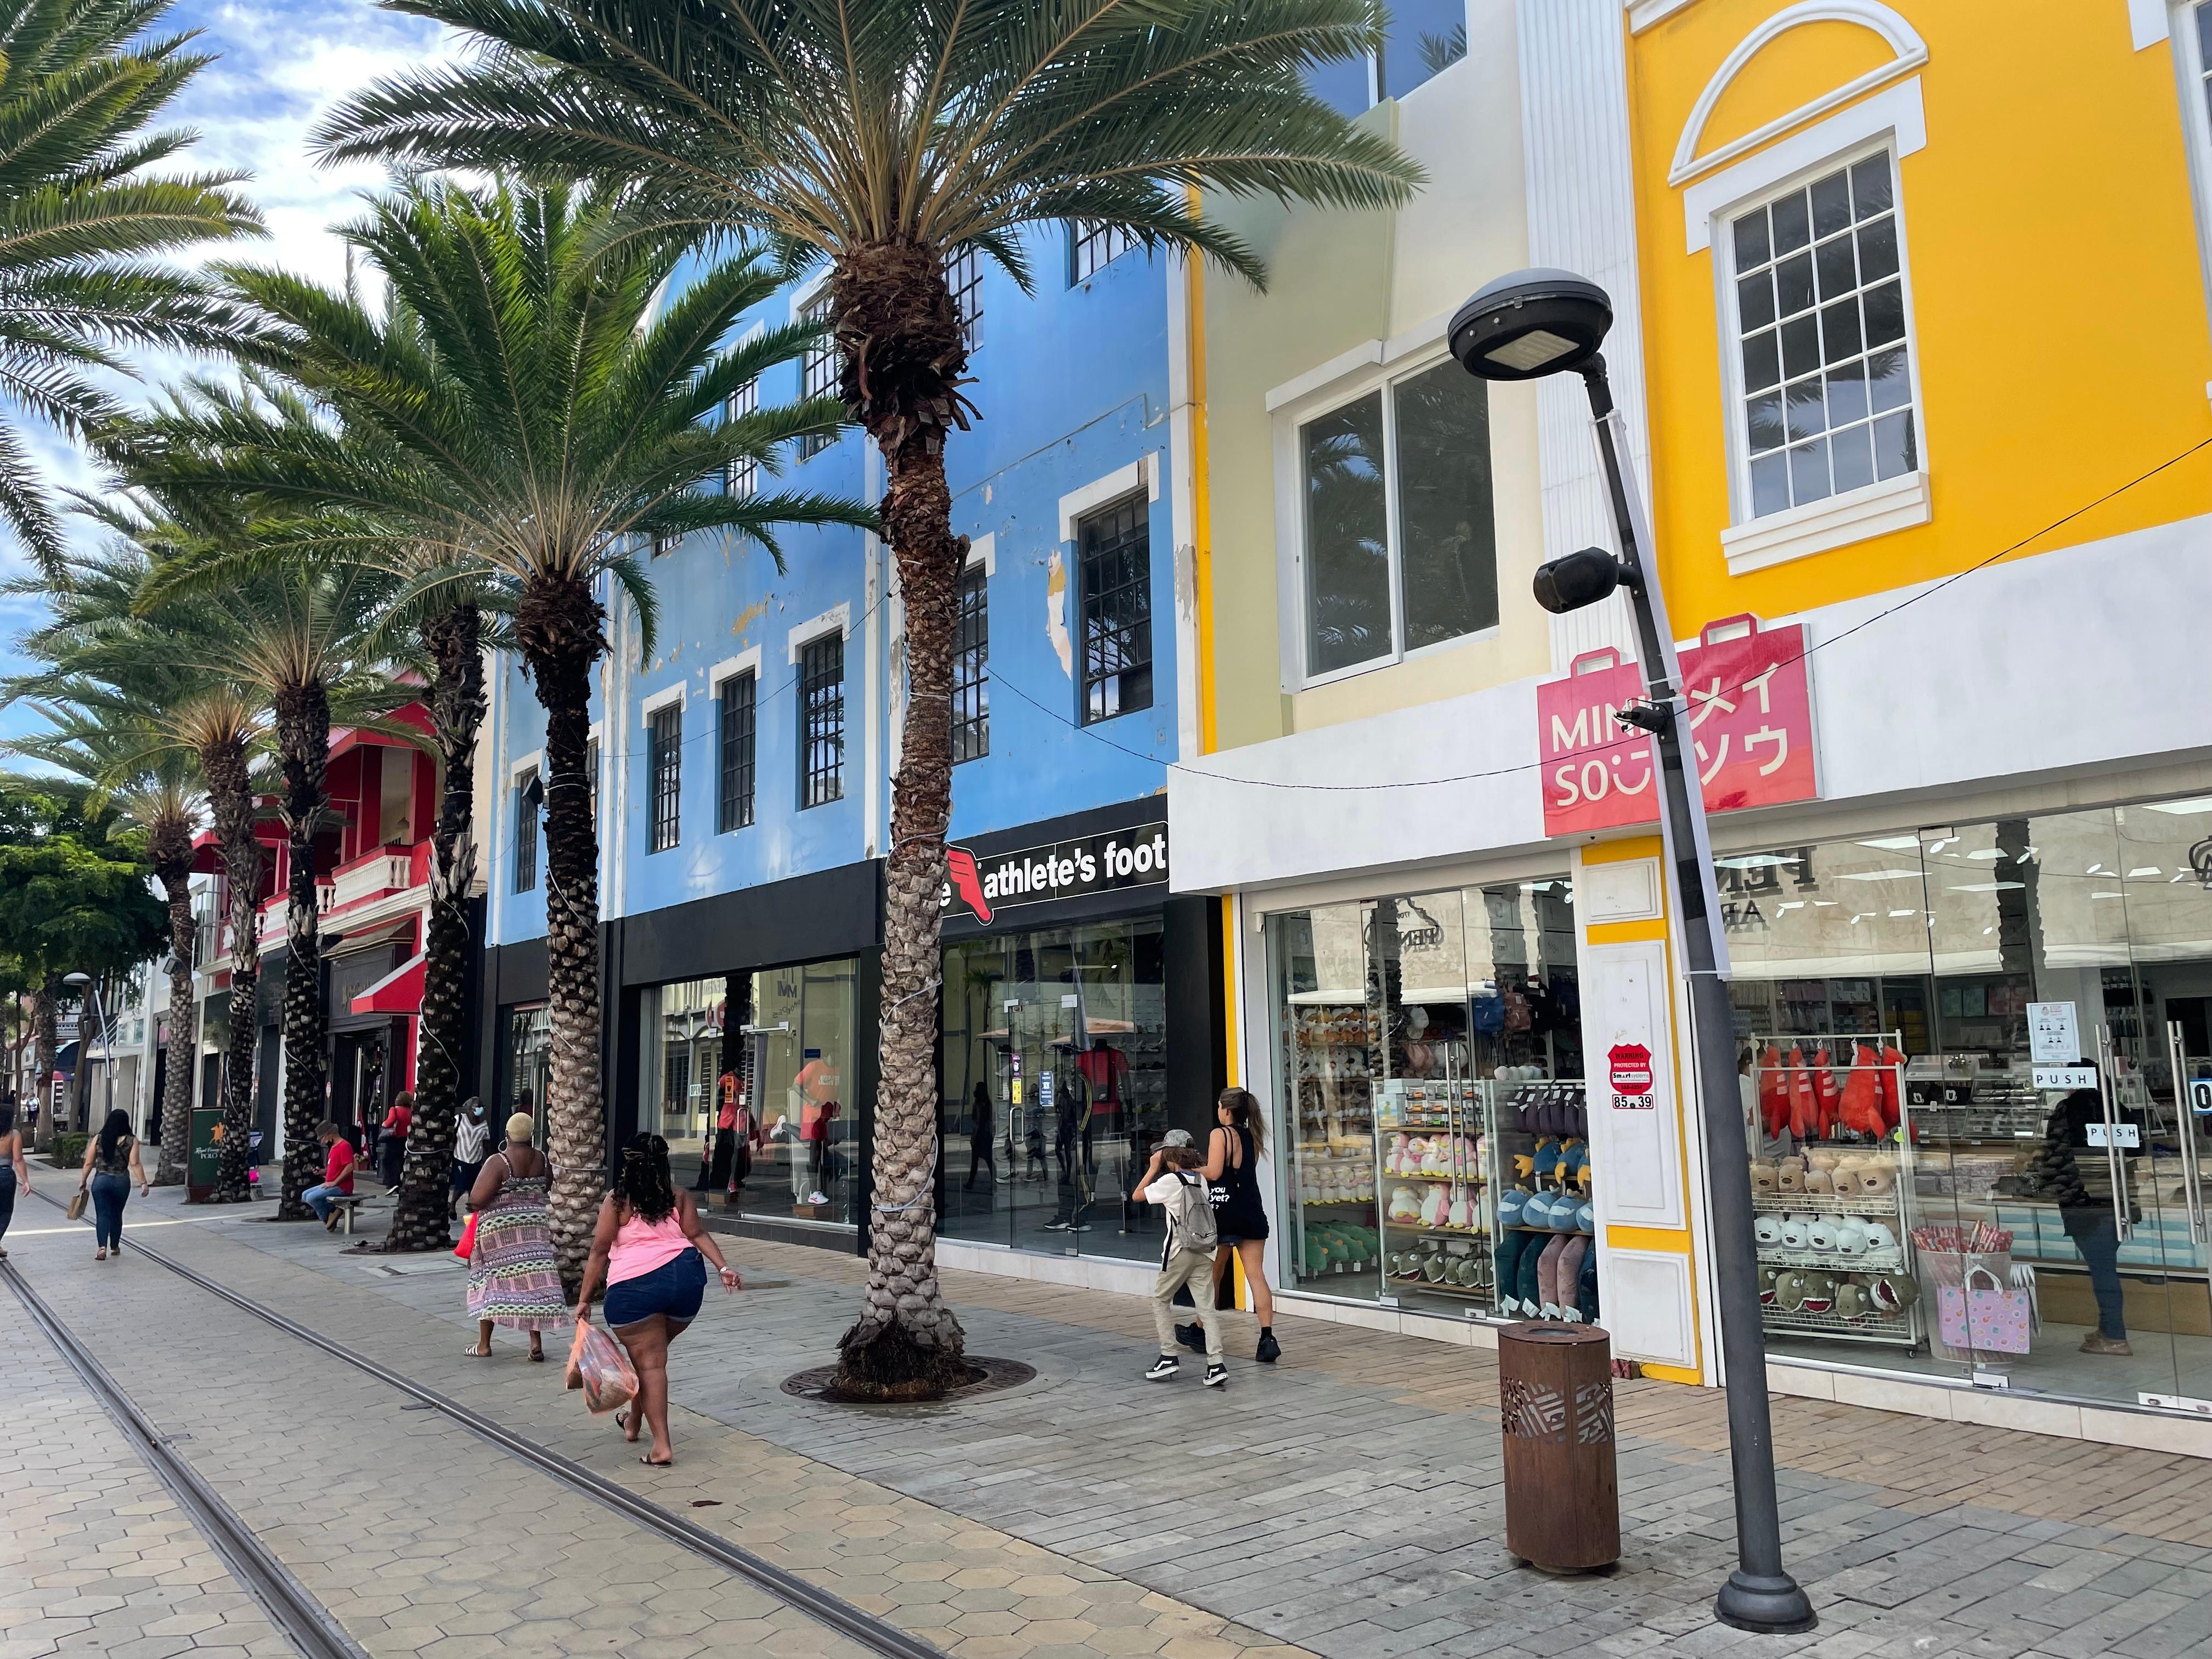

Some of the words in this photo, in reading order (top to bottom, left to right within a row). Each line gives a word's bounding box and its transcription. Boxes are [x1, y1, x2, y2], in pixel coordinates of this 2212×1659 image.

[1690, 662, 1780, 730] メイ
[1694, 724, 1788, 787] ソウ
[1103, 833, 1166, 878] foot
[2036, 1074, 2087, 1084] PUSH
[1209, 1187, 1226, 1195] you
[1209, 1194, 1230, 1202] yet?
